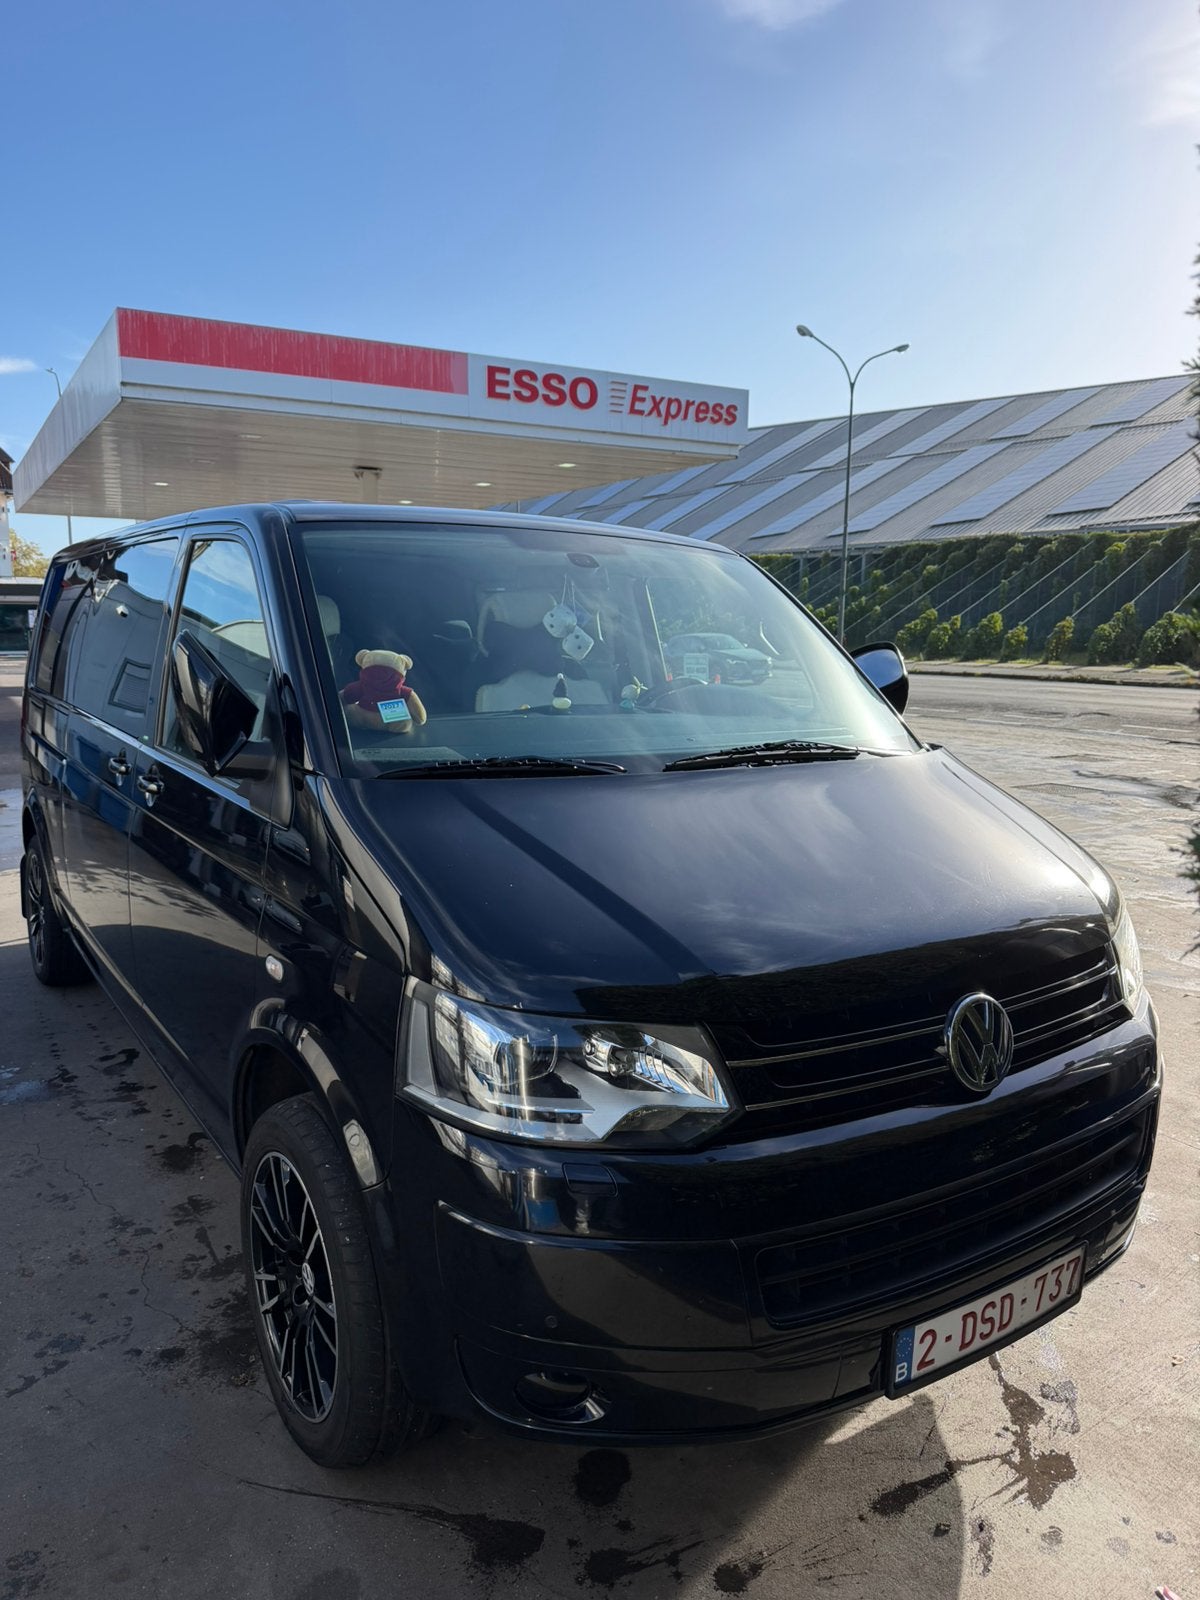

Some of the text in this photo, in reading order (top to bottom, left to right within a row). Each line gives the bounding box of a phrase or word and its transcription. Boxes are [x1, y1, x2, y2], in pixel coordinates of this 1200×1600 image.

[487, 365, 738, 426] ESSO Express
[916, 1255, 1081, 1371] 2-DSD-737
[895, 1361, 908, 1382] B
